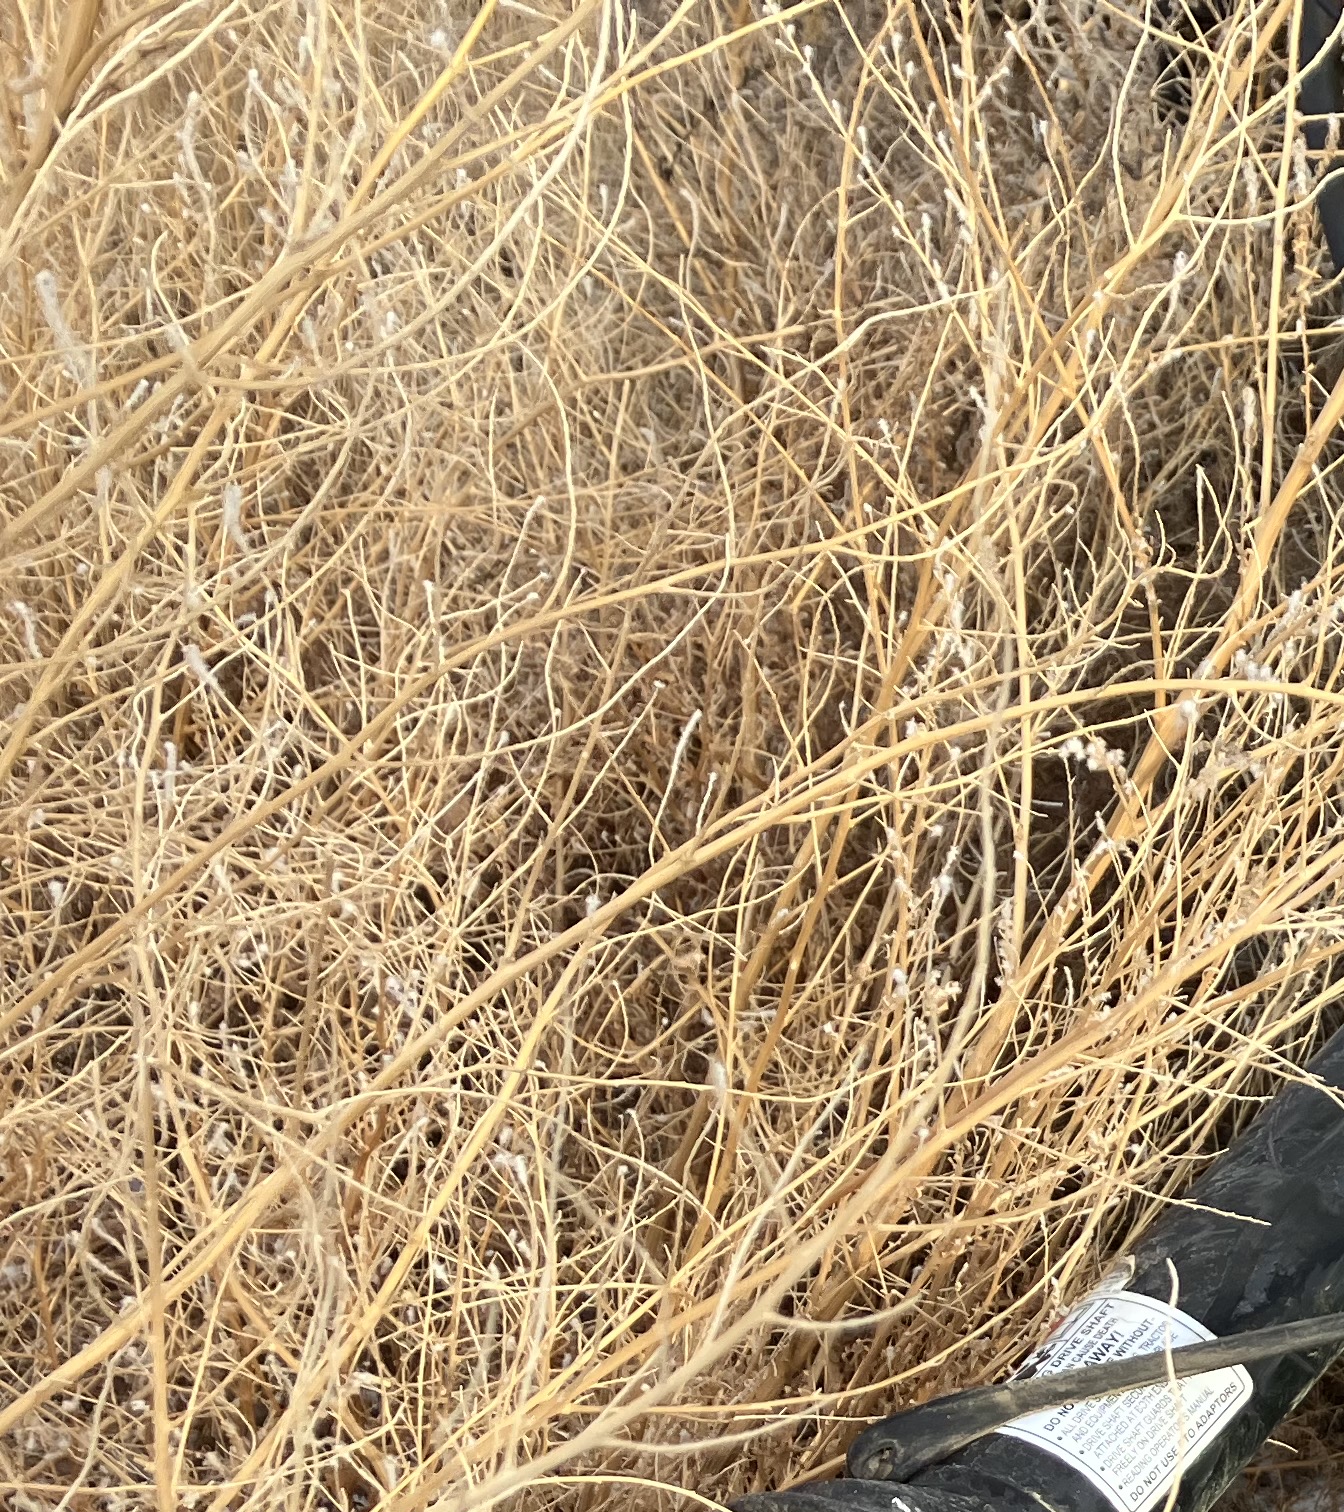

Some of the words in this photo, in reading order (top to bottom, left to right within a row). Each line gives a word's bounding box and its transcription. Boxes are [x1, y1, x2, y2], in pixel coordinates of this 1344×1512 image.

[1051, 1335, 1084, 1367] DRIVE
[1081, 1304, 1115, 1336] SHAFT
[1071, 1337, 1098, 1363] CAUSE
[1096, 1317, 1118, 1339] DEATH
[1043, 1416, 1061, 1431] DO
[1057, 1402, 1075, 1417] NO
[1061, 1423, 1077, 1436] ALL
[1073, 1401, 1095, 1424] DRIVE
[1071, 1426, 1089, 1443] AND
[1082, 1427, 1106, 1451] DRIVE
[1101, 1405, 1125, 1431] SHAFT
[1093, 1420, 1130, 1459] ATTACHED
[1126, 1410, 1138, 1424] AT
[1102, 1444, 1126, 1468] DRIVE
[1122, 1422, 1146, 1448] SHAFT
[1142, 1394, 1172, 1425] GUARDS
[1121, 1453, 1153, 1487] READING
[1186, 1386, 1214, 1416] MANUAL
[1111, 1446, 1140, 1477] FREELY
[1136, 1436, 1150, 1450] ON
[1146, 1416, 1168, 1440] DRIVE
[1129, 1484, 1145, 1502] DO
[1142, 1464, 1162, 1487] NOT
[1160, 1445, 1178, 1468] USE
[1194, 1381, 1238, 1430] ADAPTORS
